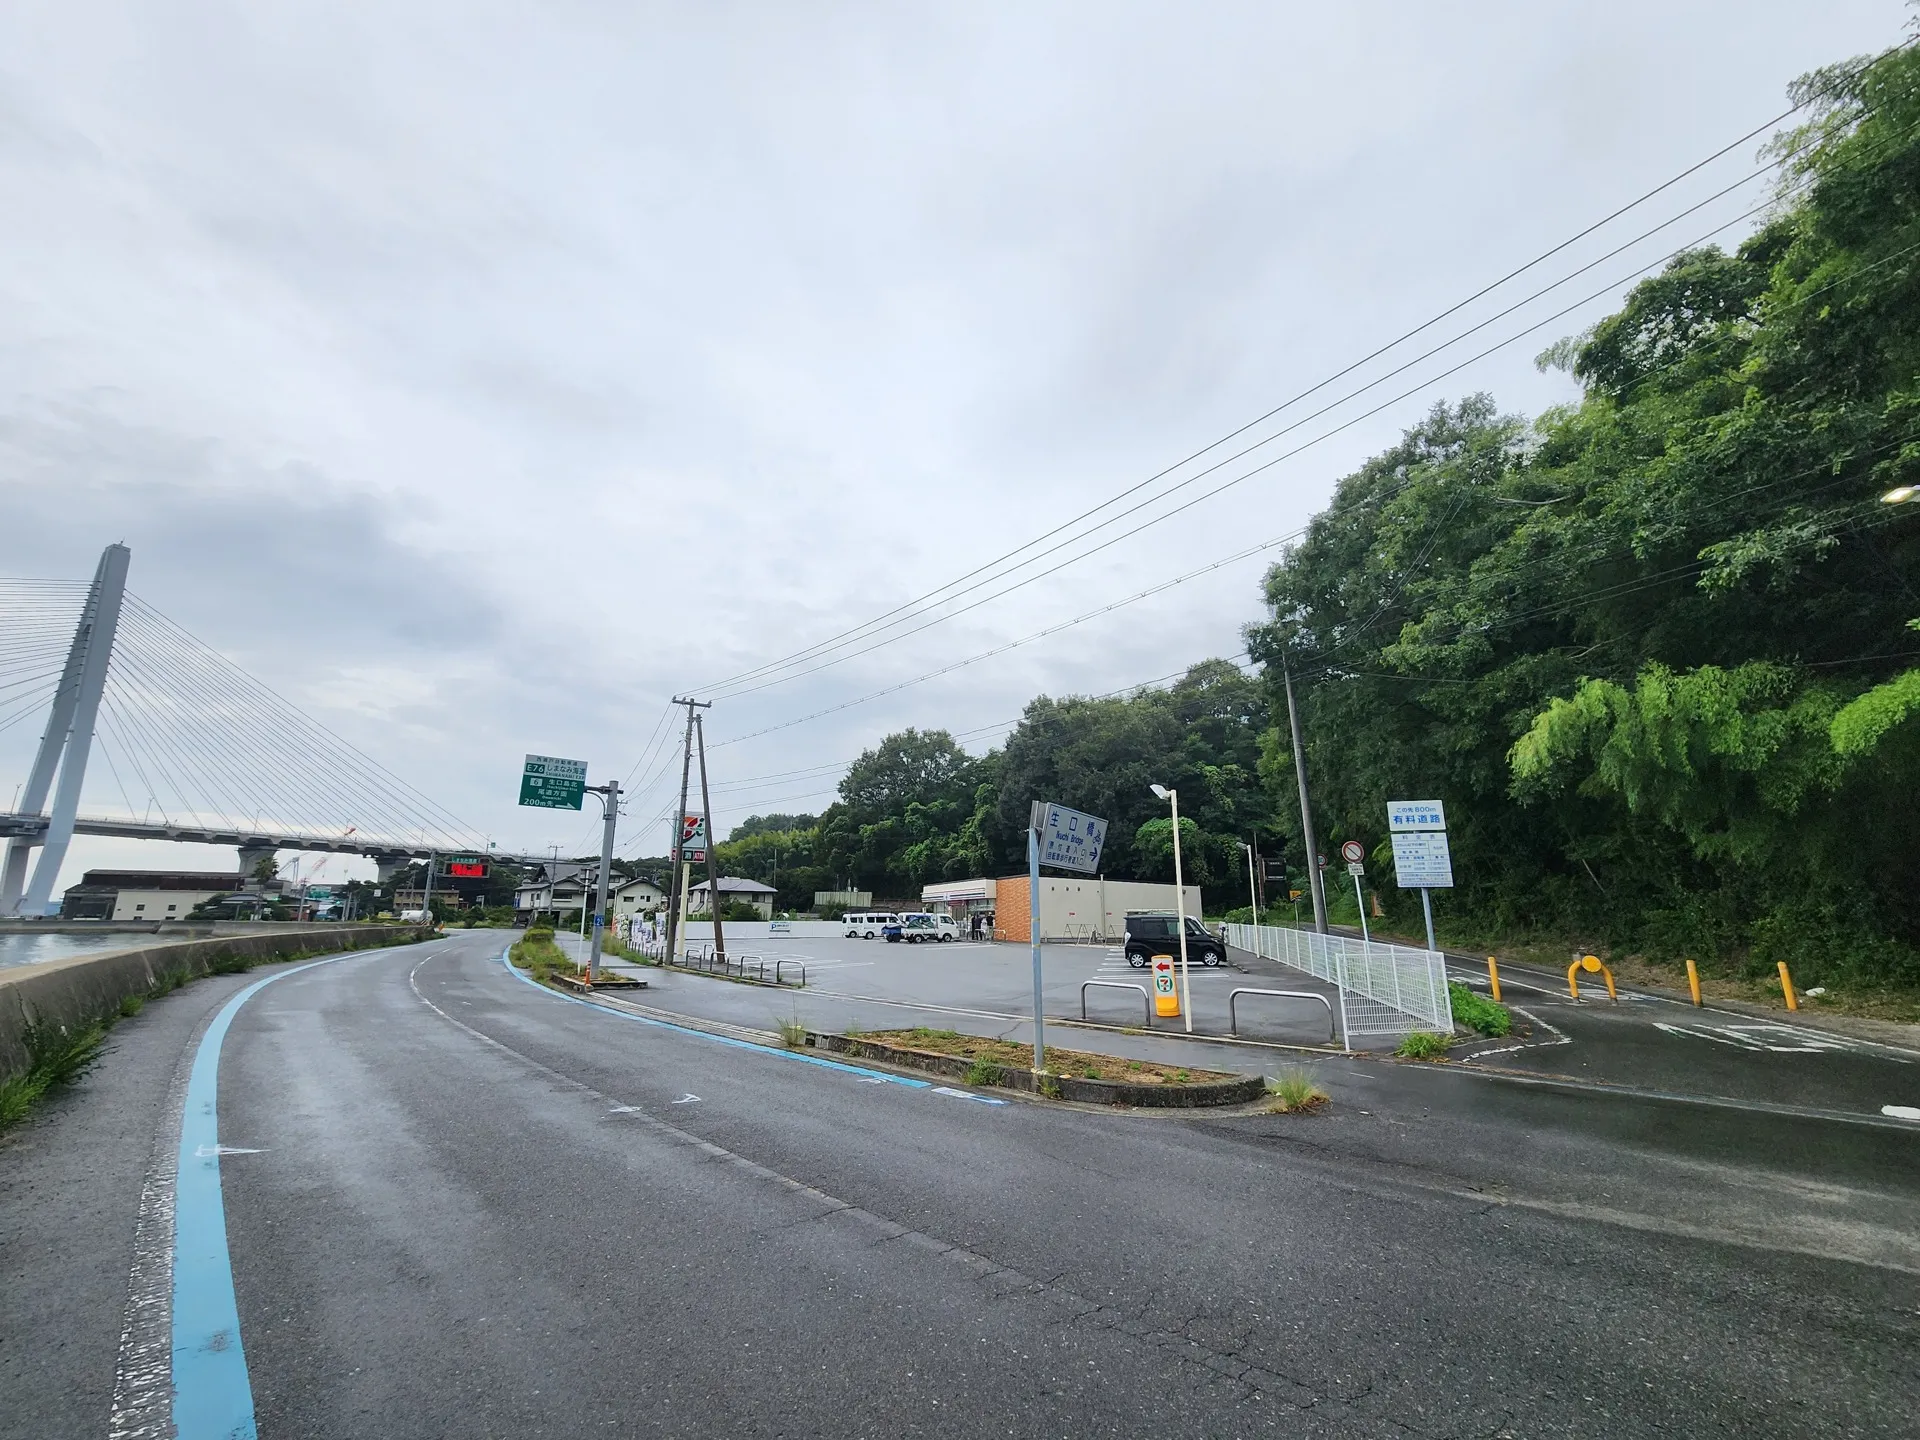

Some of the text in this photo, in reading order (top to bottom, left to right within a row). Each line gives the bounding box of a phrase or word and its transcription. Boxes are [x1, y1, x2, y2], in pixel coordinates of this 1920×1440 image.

[527, 764, 544, 773] E76
[523, 798, 554, 808] 200m先
[1049, 810, 1095, 837] 生口橋
[1393, 814, 1440, 825] 有料道路
